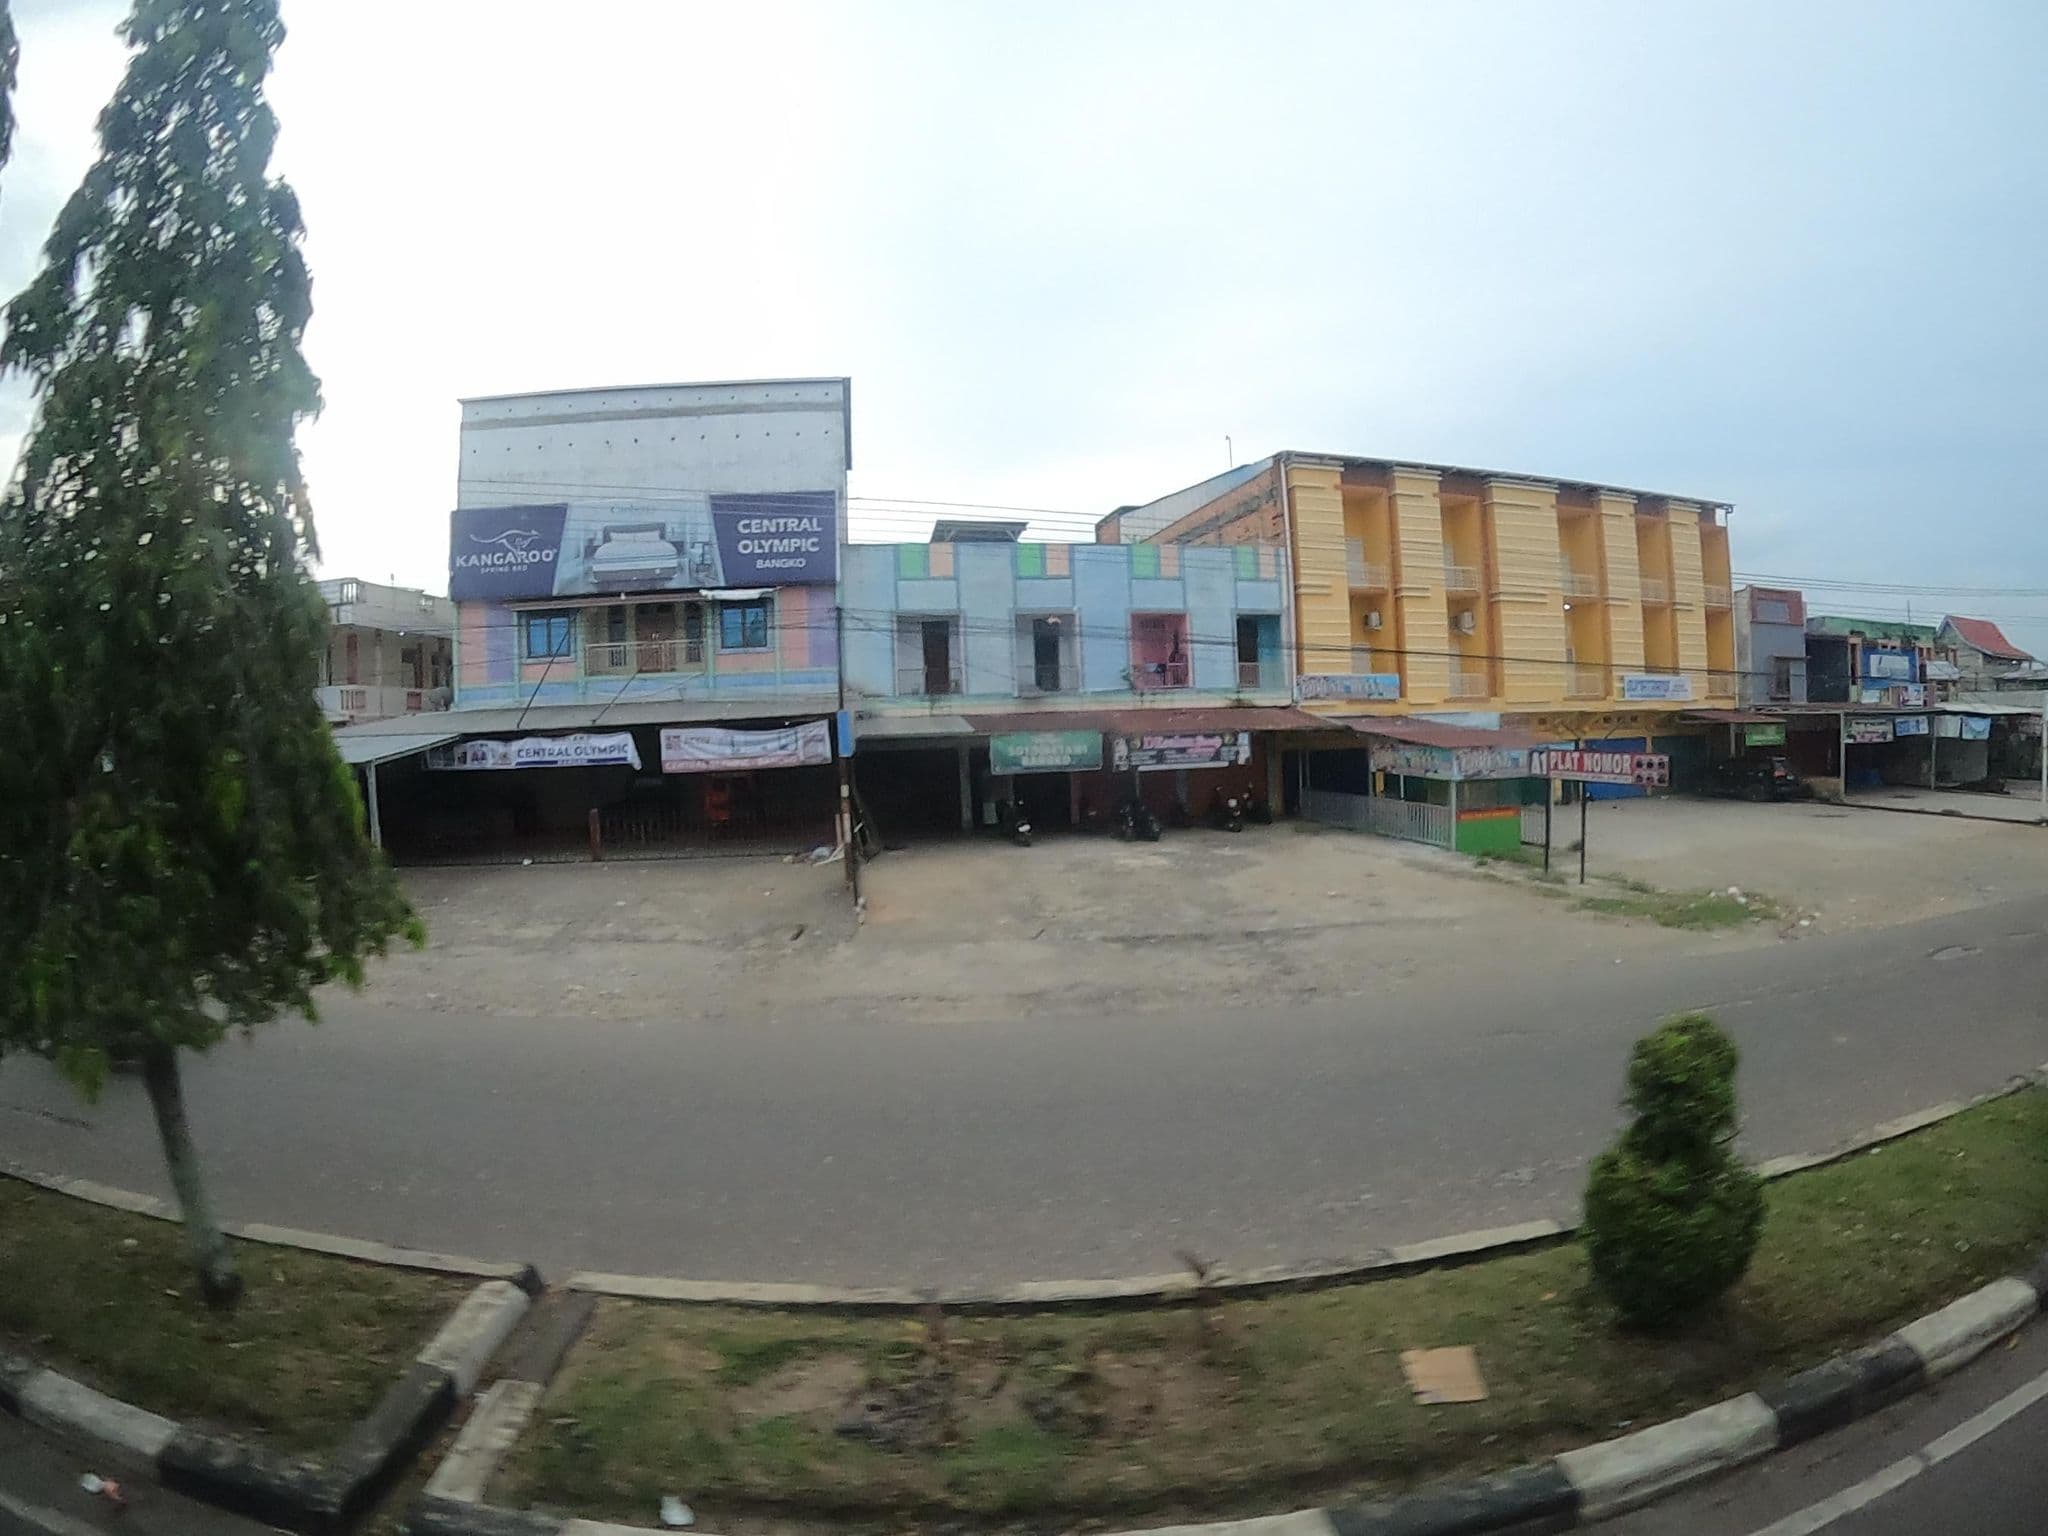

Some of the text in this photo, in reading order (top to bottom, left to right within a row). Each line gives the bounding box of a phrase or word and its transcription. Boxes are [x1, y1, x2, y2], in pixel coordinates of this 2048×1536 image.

[737, 517, 823, 534] CENTRAL
[737, 538, 820, 554] OLYMPIC
[456, 549, 554, 568] KANGAROO
[756, 558, 807, 569] BANGKO
[517, 744, 628, 759] CENTRAL OLYMPIC
[1531, 751, 1547, 775] A1
[1550, 751, 1580, 771] PLAT
[1583, 752, 1632, 774] NOMOR
